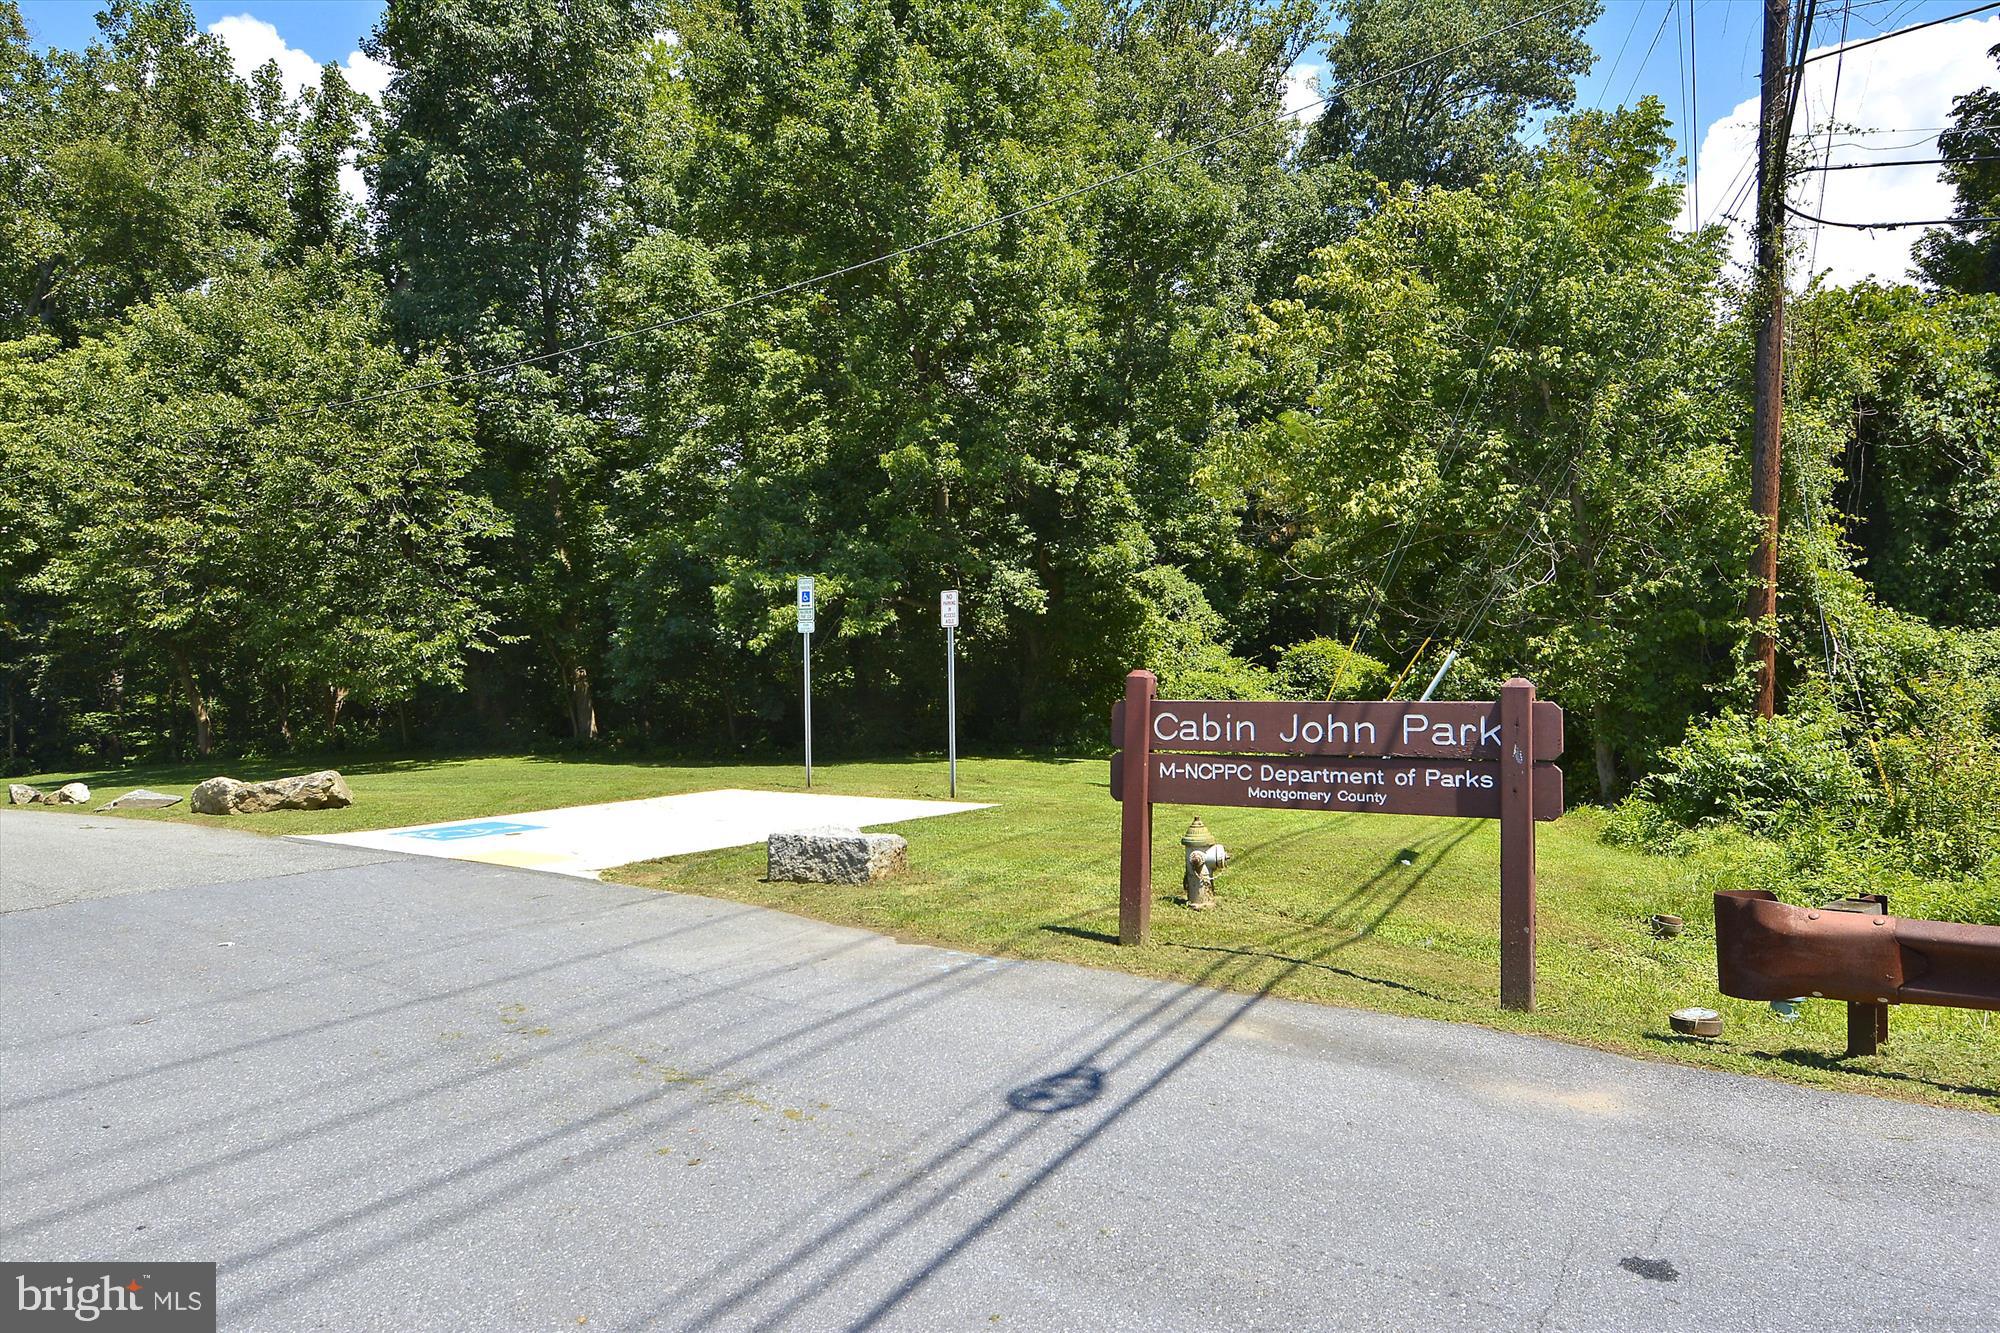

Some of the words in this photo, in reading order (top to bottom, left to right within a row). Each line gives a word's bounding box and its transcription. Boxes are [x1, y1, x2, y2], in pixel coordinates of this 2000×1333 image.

[1153, 712, 1255, 742] Cabin
[1279, 713, 1376, 744] John
[1403, 714, 1502, 746] Park
[1159, 762, 1253, 780] M-NCPPC
[1260, 764, 1385, 786] Department
[1394, 768, 1416, 786] of
[1425, 769, 1494, 788] Parks
[1248, 787, 1331, 803] Montgomery
[1337, 790, 1387, 806] County
